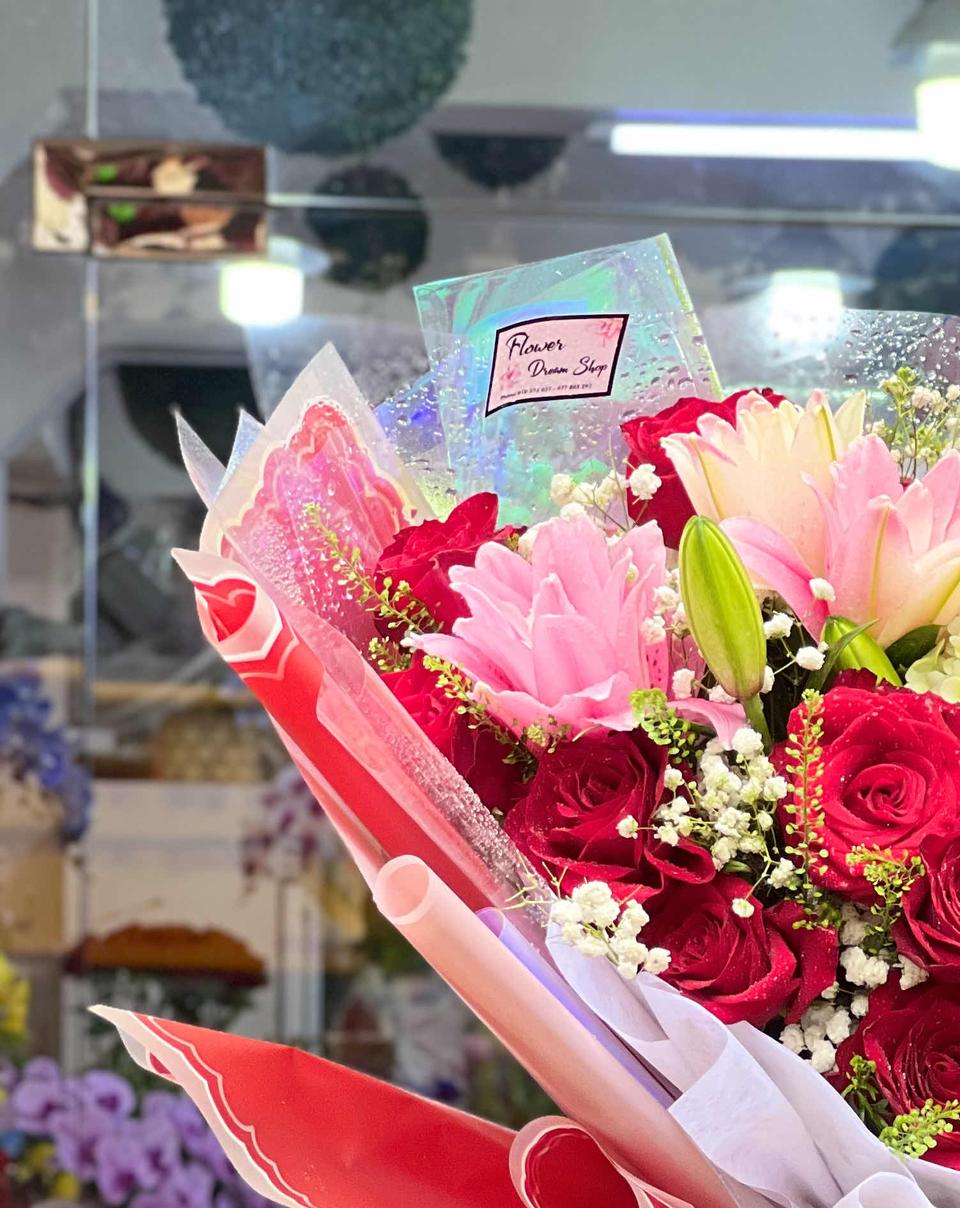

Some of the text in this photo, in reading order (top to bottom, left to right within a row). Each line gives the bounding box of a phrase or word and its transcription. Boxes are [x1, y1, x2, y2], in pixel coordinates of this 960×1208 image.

[506, 332, 565, 360] Flower
[528, 356, 608, 378] Dream Shop
